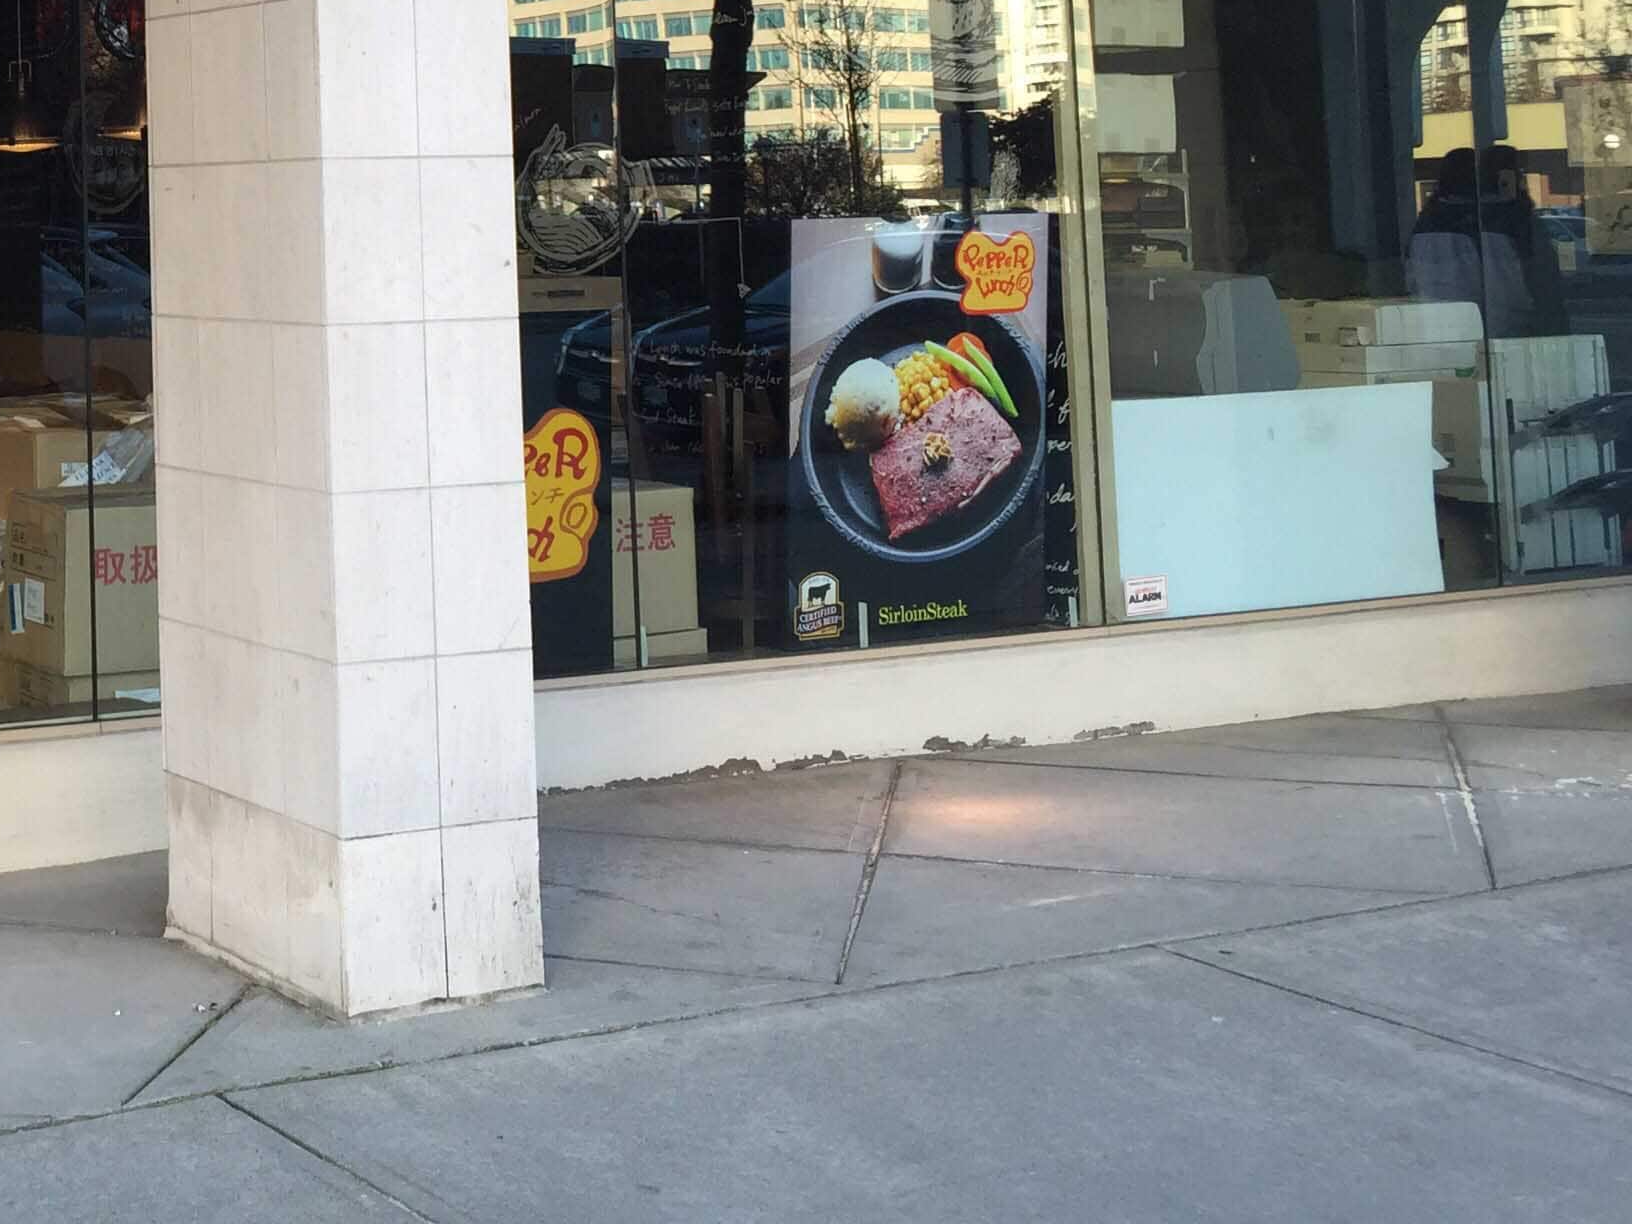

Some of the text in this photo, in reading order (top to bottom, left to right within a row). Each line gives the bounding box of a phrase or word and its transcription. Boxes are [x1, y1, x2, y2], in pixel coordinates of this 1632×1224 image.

[615, 512, 676, 553] 注意
[95, 544, 158, 585] 取扱
[1128, 591, 1162, 605] ALARM
